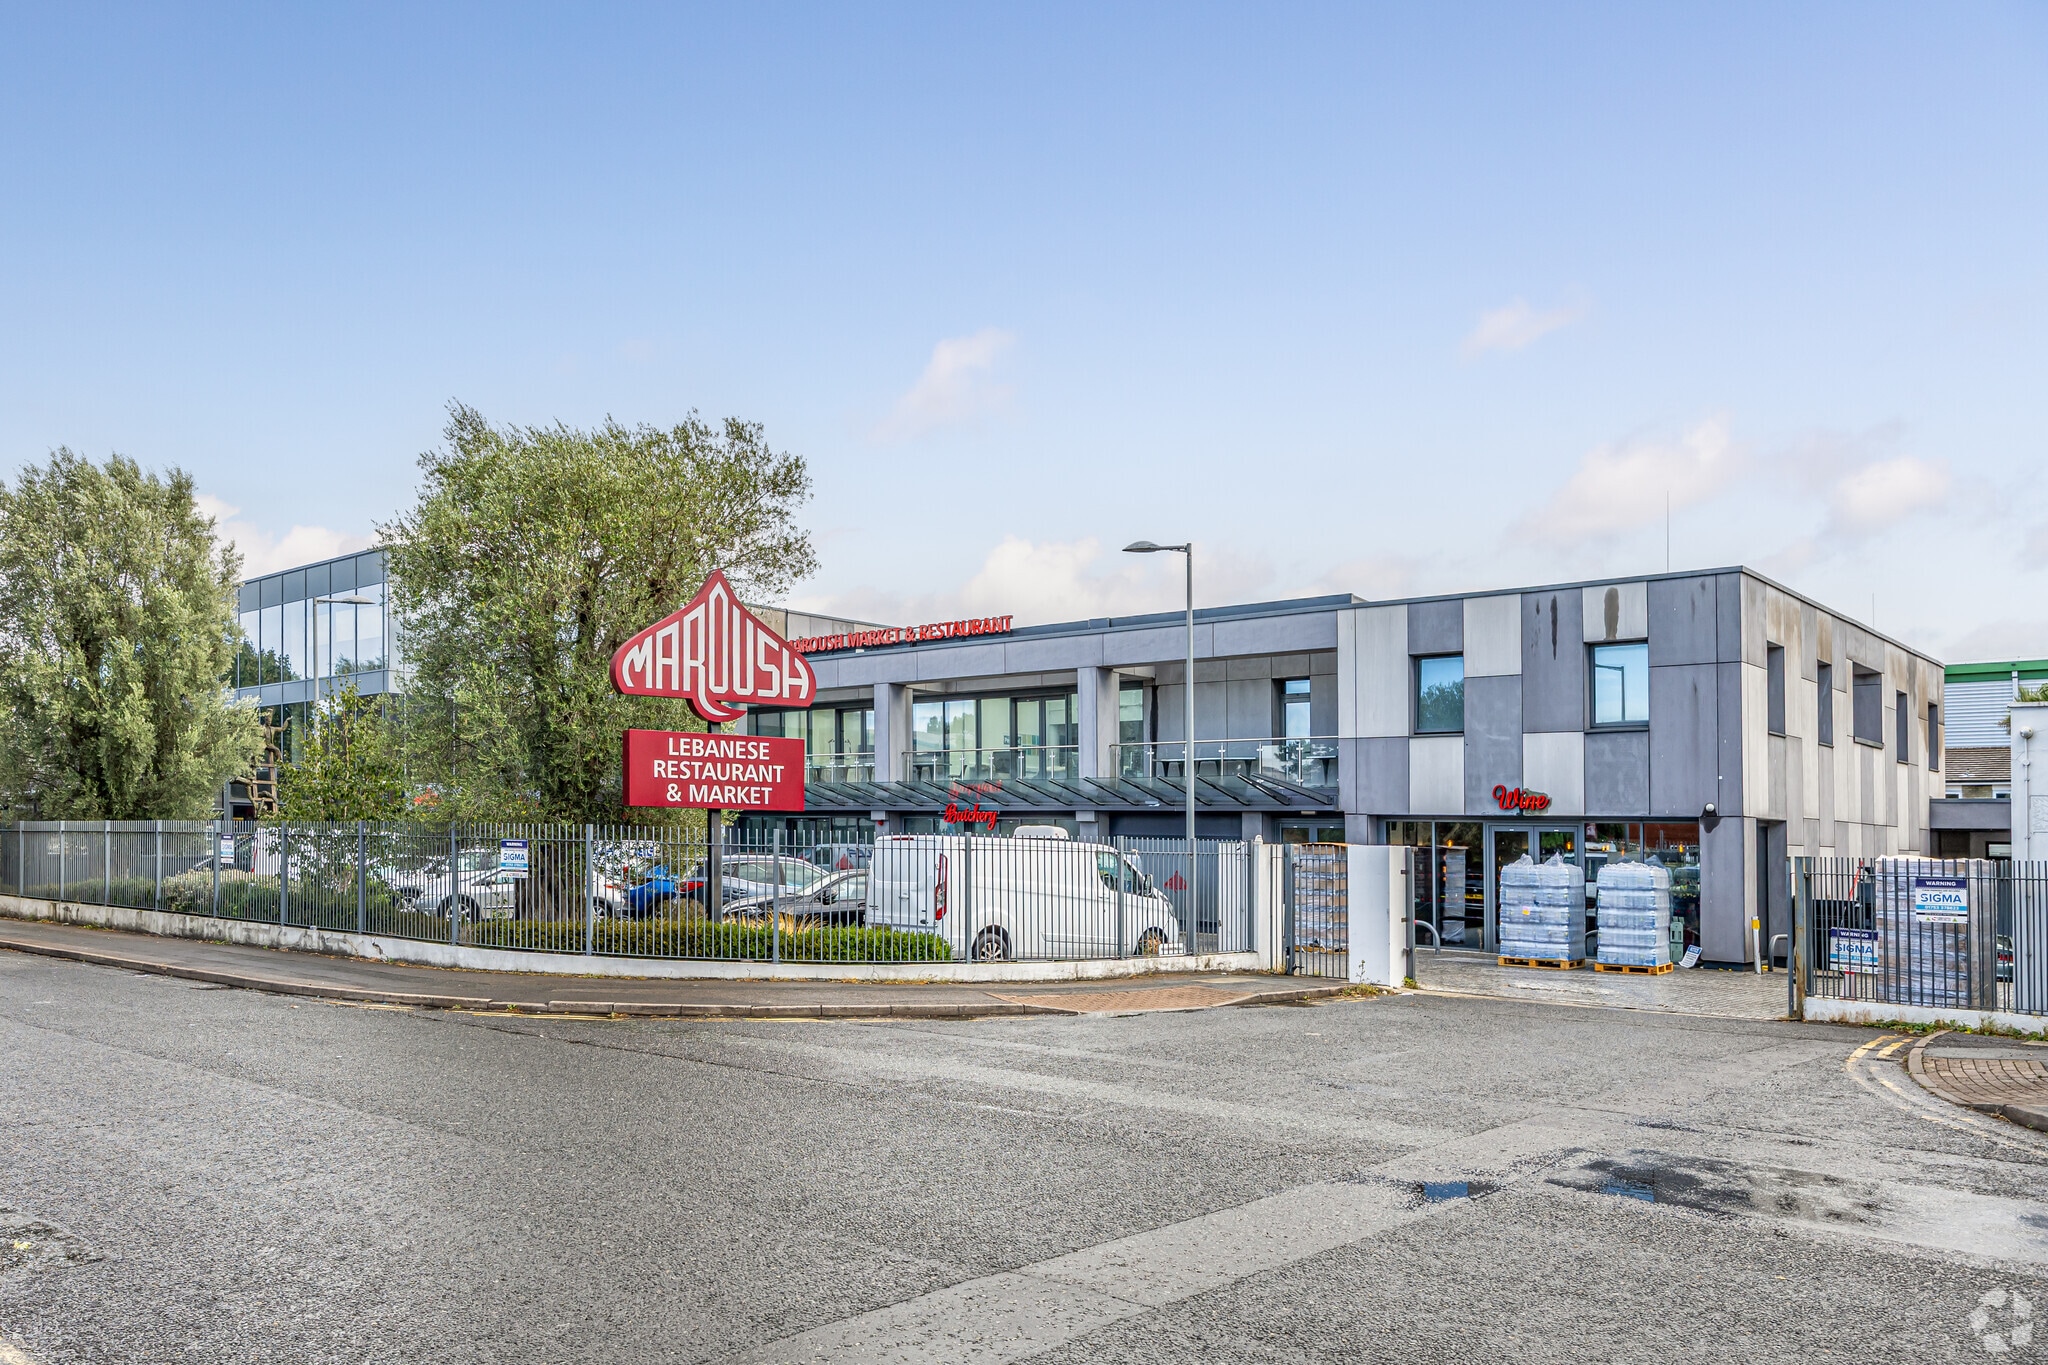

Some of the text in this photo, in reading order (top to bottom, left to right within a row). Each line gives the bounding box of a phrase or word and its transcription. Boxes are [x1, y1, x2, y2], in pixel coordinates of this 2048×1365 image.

[847, 627, 902, 648] MARKET
[905, 626, 916, 643] &
[919, 615, 1014, 641] RESTAURANT
[622, 581, 810, 716] MAROUSH
[668, 737, 770, 760] LEBANESE
[653, 759, 785, 783] RESTAURANT
[666, 783, 773, 805] & MARKET
[1492, 784, 1550, 811] Wine
[943, 802, 998, 830] Butchery
[503, 852, 525, 861] SIGMA
[1920, 893, 1962, 903] SIGMA
[1835, 943, 1873, 954] SIGMA
